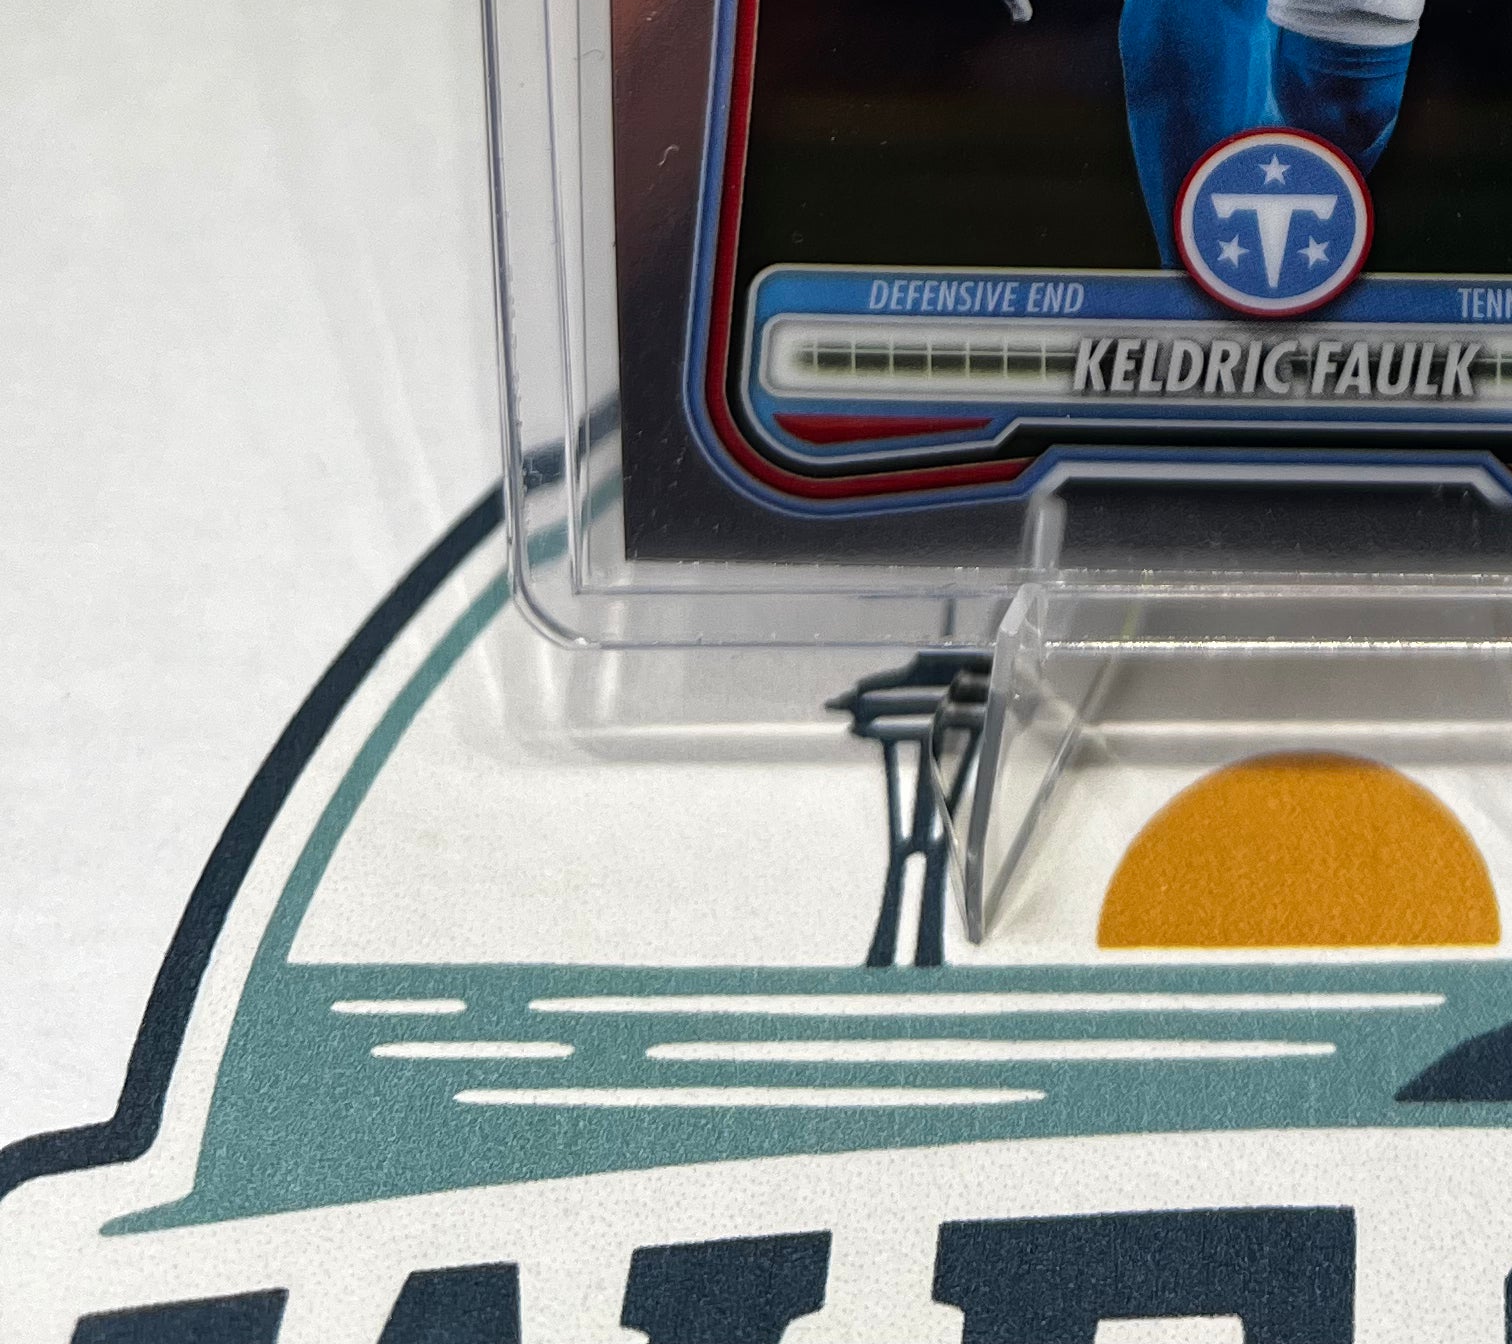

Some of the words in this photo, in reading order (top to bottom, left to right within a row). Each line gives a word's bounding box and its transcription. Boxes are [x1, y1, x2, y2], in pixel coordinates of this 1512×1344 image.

[868, 279, 1018, 312] DEFENSIVE
[1026, 281, 1086, 314] END
[1072, 337, 1299, 394] KELDRIC
[1310, 340, 1481, 396] FAULK
